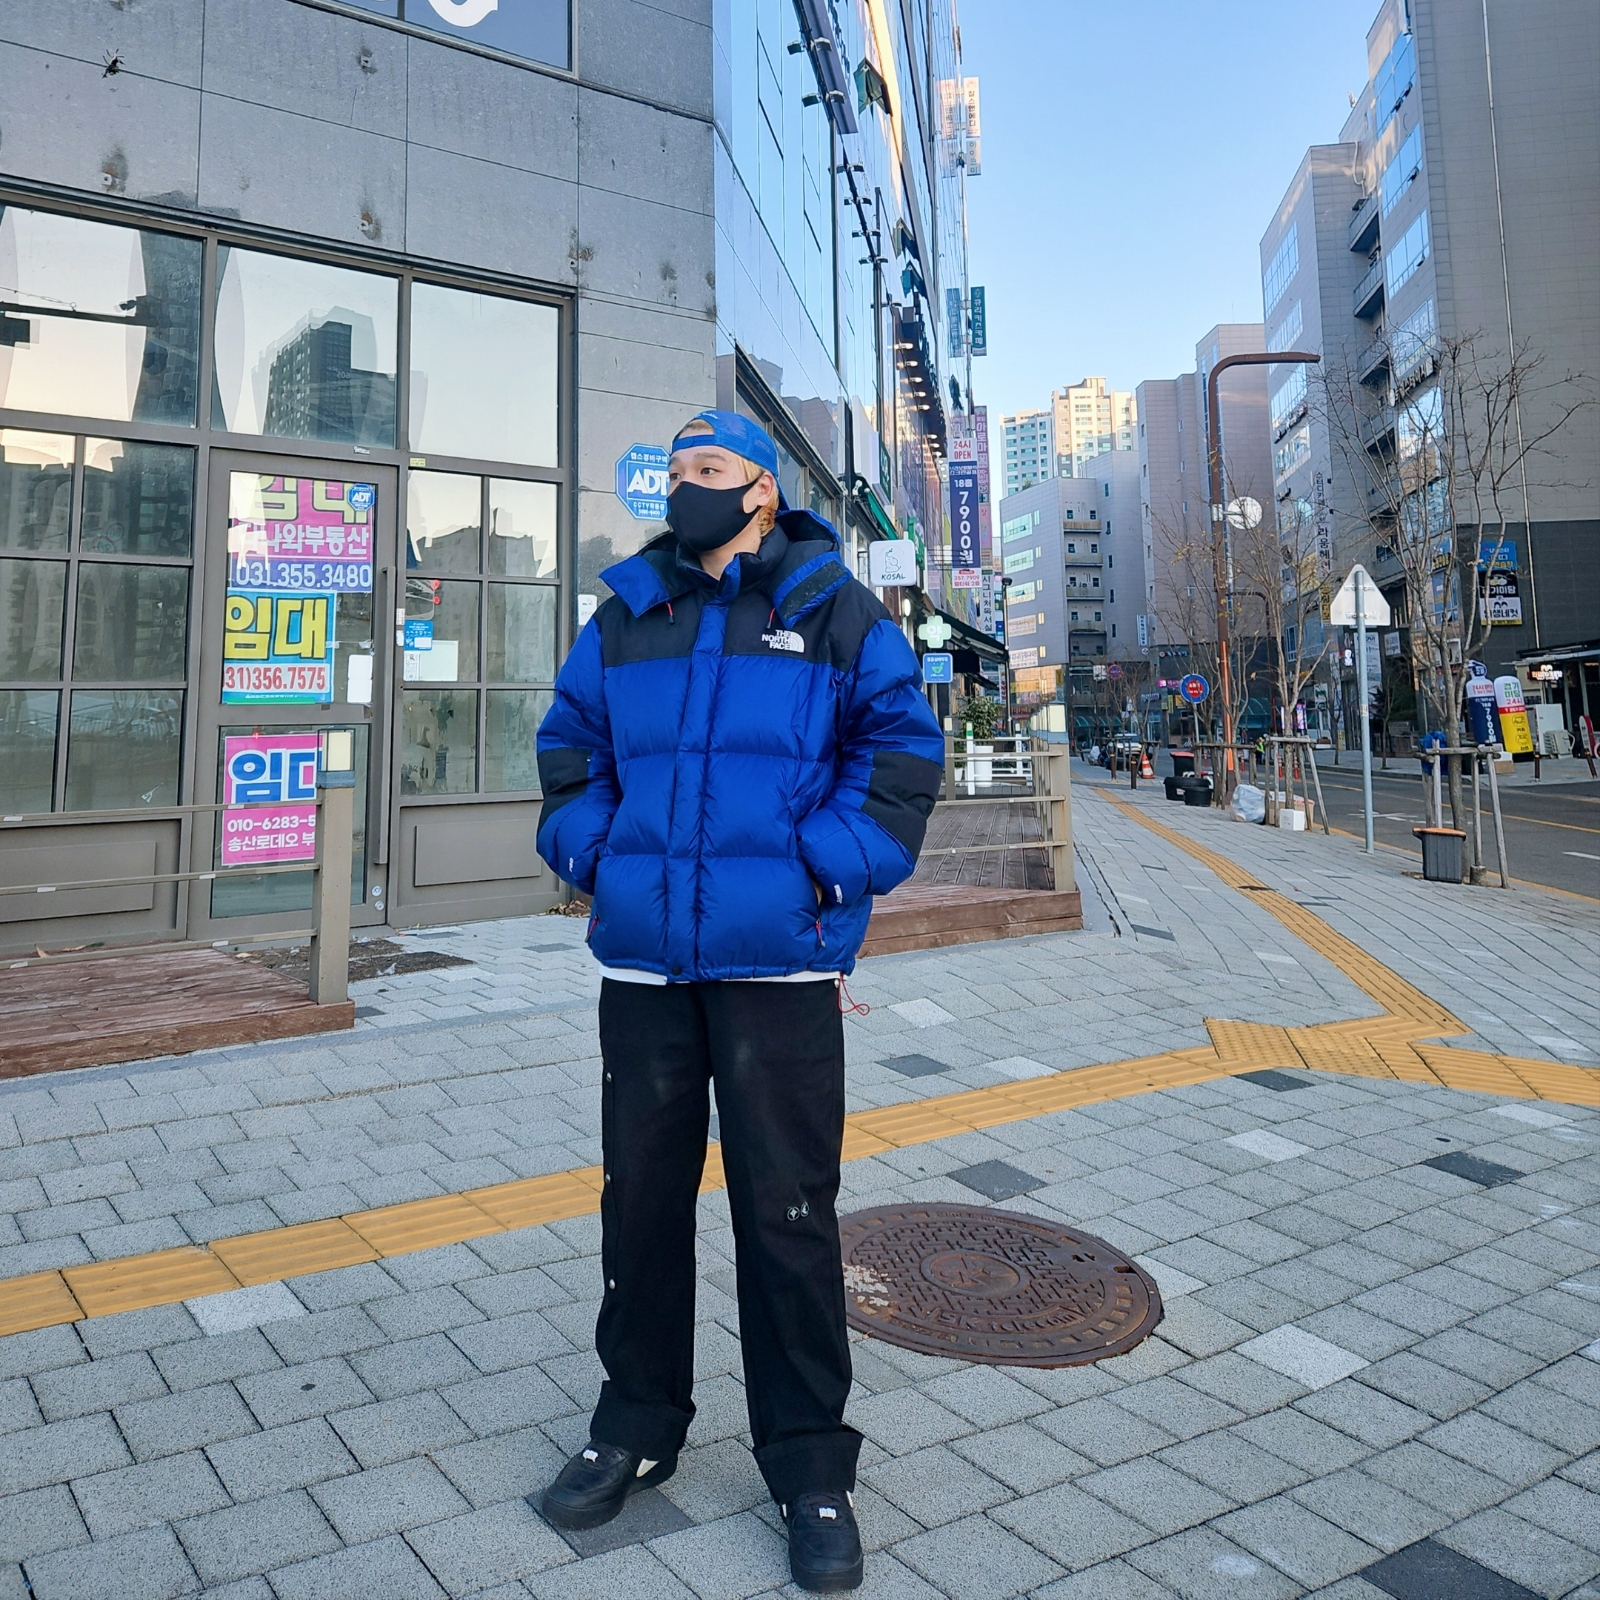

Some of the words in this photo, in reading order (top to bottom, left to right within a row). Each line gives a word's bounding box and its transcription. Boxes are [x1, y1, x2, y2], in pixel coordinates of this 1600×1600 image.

[953, 440, 971, 449] 24시
[953, 450, 971, 460] OPEN
[628, 468, 669, 496] ADT
[352, 491, 371, 502] ADT
[239, 522, 369, 556] 나와부동산
[236, 561, 372, 588] 031.355.3480
[982, 575, 993, 632] 시그니처독서실
[223, 595, 328, 660] 임대
[775, 629, 792, 637] THE
[926, 625, 942, 641] 약
[761, 633, 791, 643] NORTH
[769, 641, 791, 651] FACE
[224, 666, 326, 690] 31)356.7575
[227, 832, 299, 852] 송산로데오
[938, 1312, 981, 1328] SK
[990, 1313, 1078, 1332] telecom
